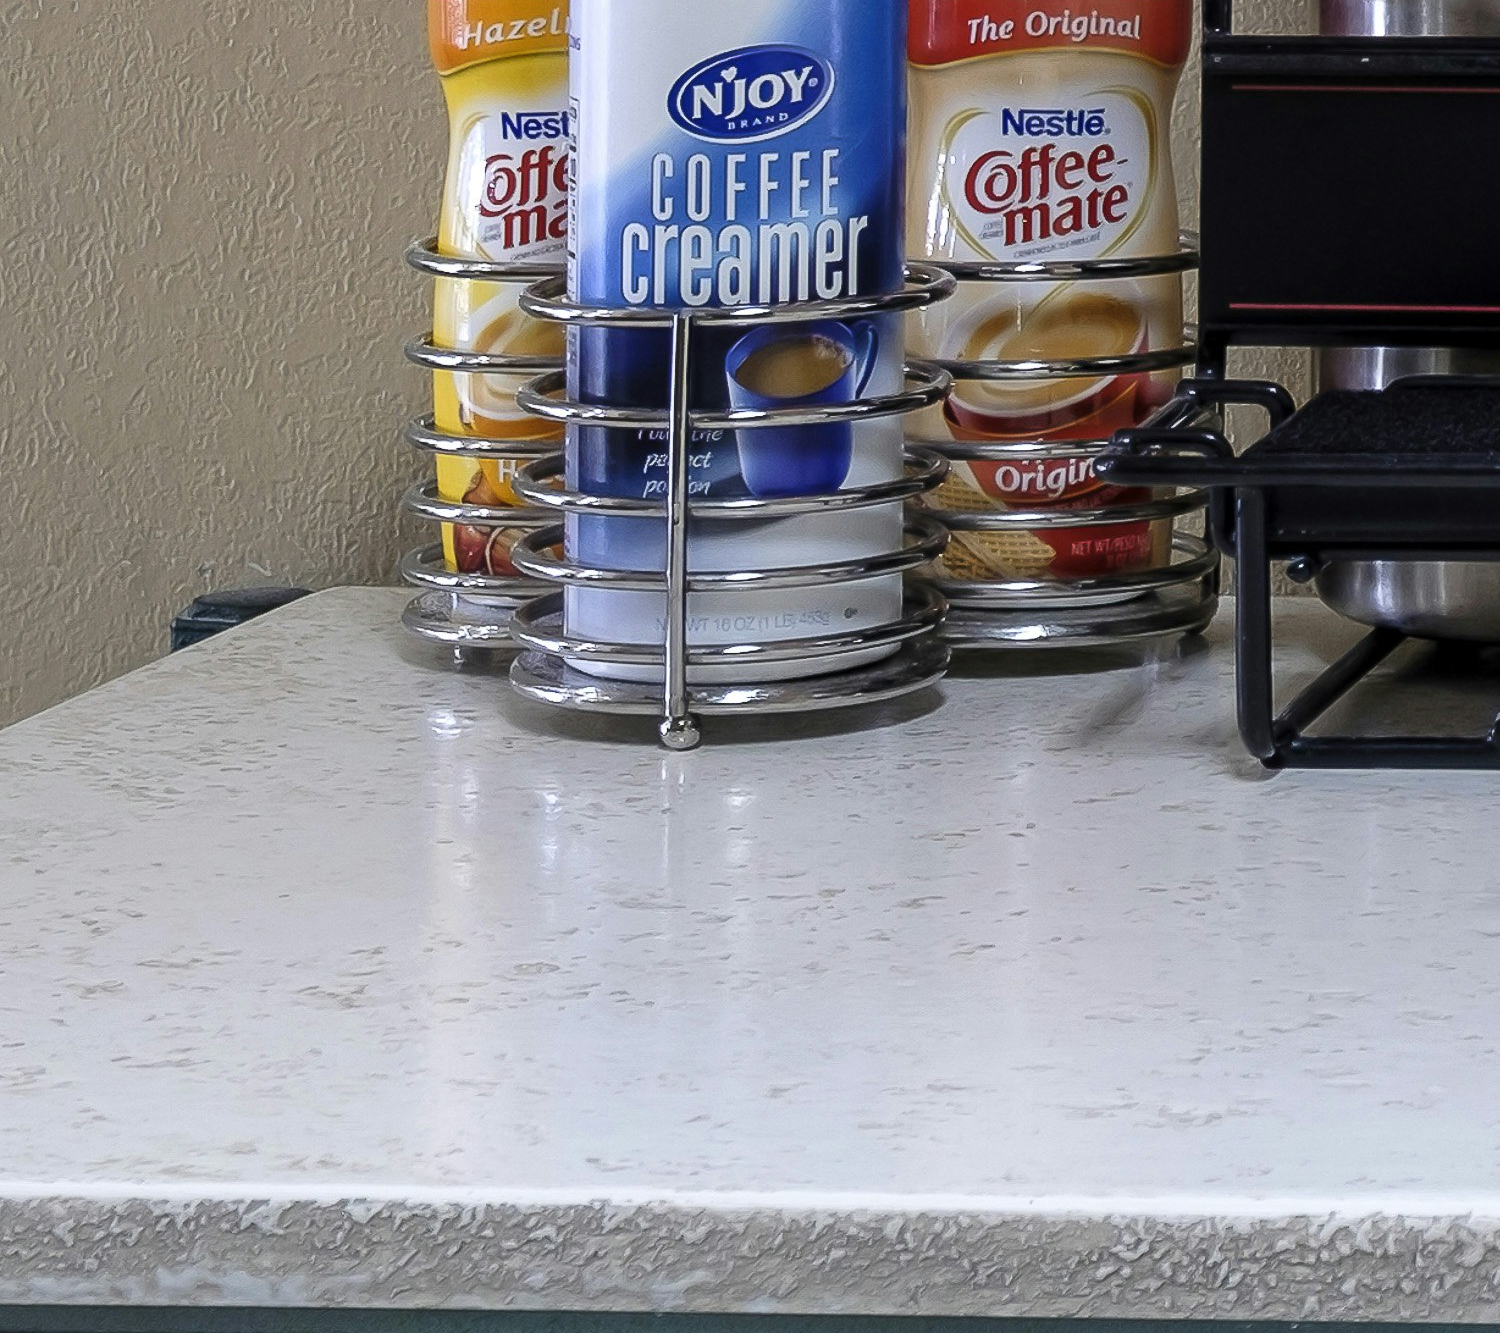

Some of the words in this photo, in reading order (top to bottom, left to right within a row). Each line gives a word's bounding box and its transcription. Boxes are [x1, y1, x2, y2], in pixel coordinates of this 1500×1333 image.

[459, 6, 570, 50] Hazel
[967, 15, 1014, 44] The
[1025, 9, 1140, 42] Original
[502, 111, 569, 140] Nest
[727, 112, 790, 130] BRAND
[652, 149, 840, 222] COFFEE
[503, 198, 569, 250] ma
[1003, 184, 1129, 247] mate
[622, 215, 868, 306] creamer
[994, 458, 1096, 499] Origin
